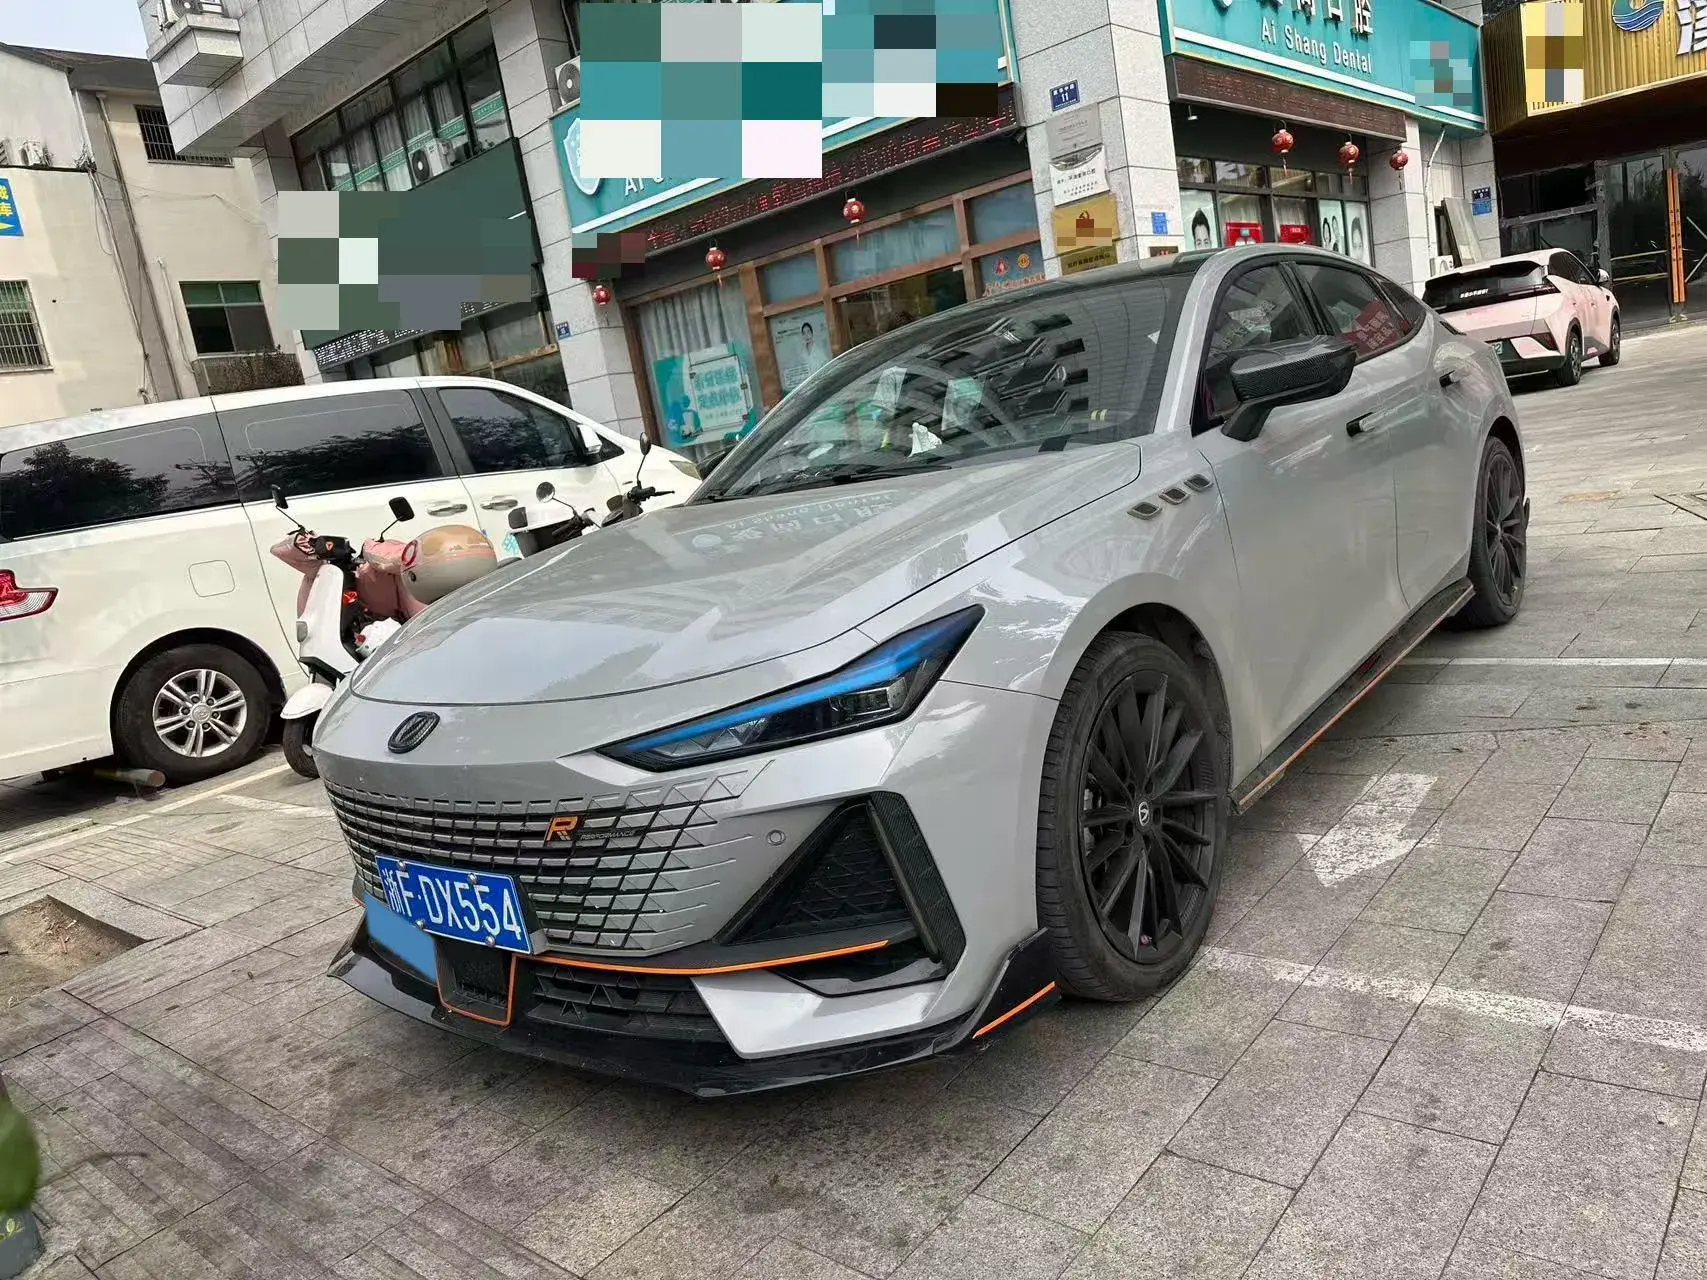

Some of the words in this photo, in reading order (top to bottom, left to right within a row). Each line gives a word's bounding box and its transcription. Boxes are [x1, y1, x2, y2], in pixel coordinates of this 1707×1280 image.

[1261, 16, 1277, 44] Ai
[1284, 24, 1327, 65] Shang
[1333, 41, 1373, 74] Dental
[1060, 92, 1070, 102] 11
[580, 830, 634, 840] PERFORMANCE
